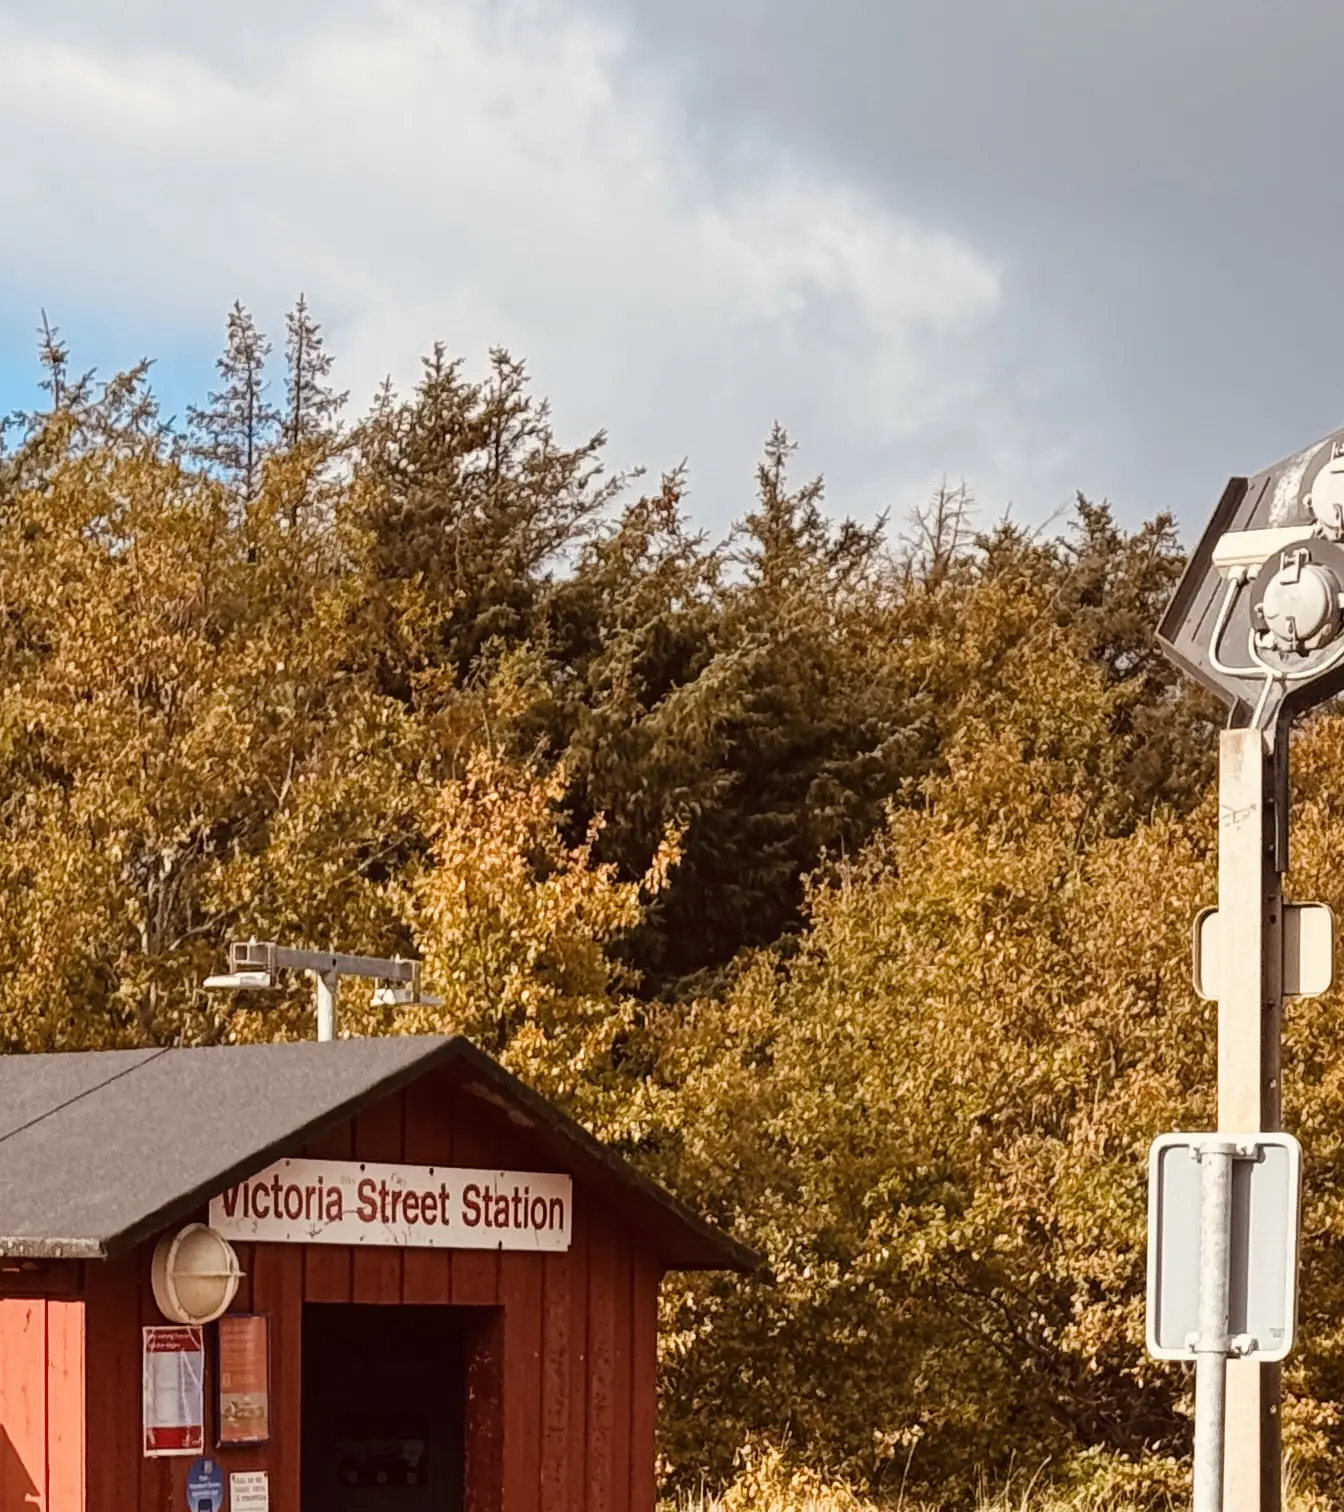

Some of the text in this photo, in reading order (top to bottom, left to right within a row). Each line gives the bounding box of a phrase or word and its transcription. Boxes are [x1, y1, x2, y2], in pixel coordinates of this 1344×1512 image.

[221, 1174, 564, 1231] Victoria Street Station
